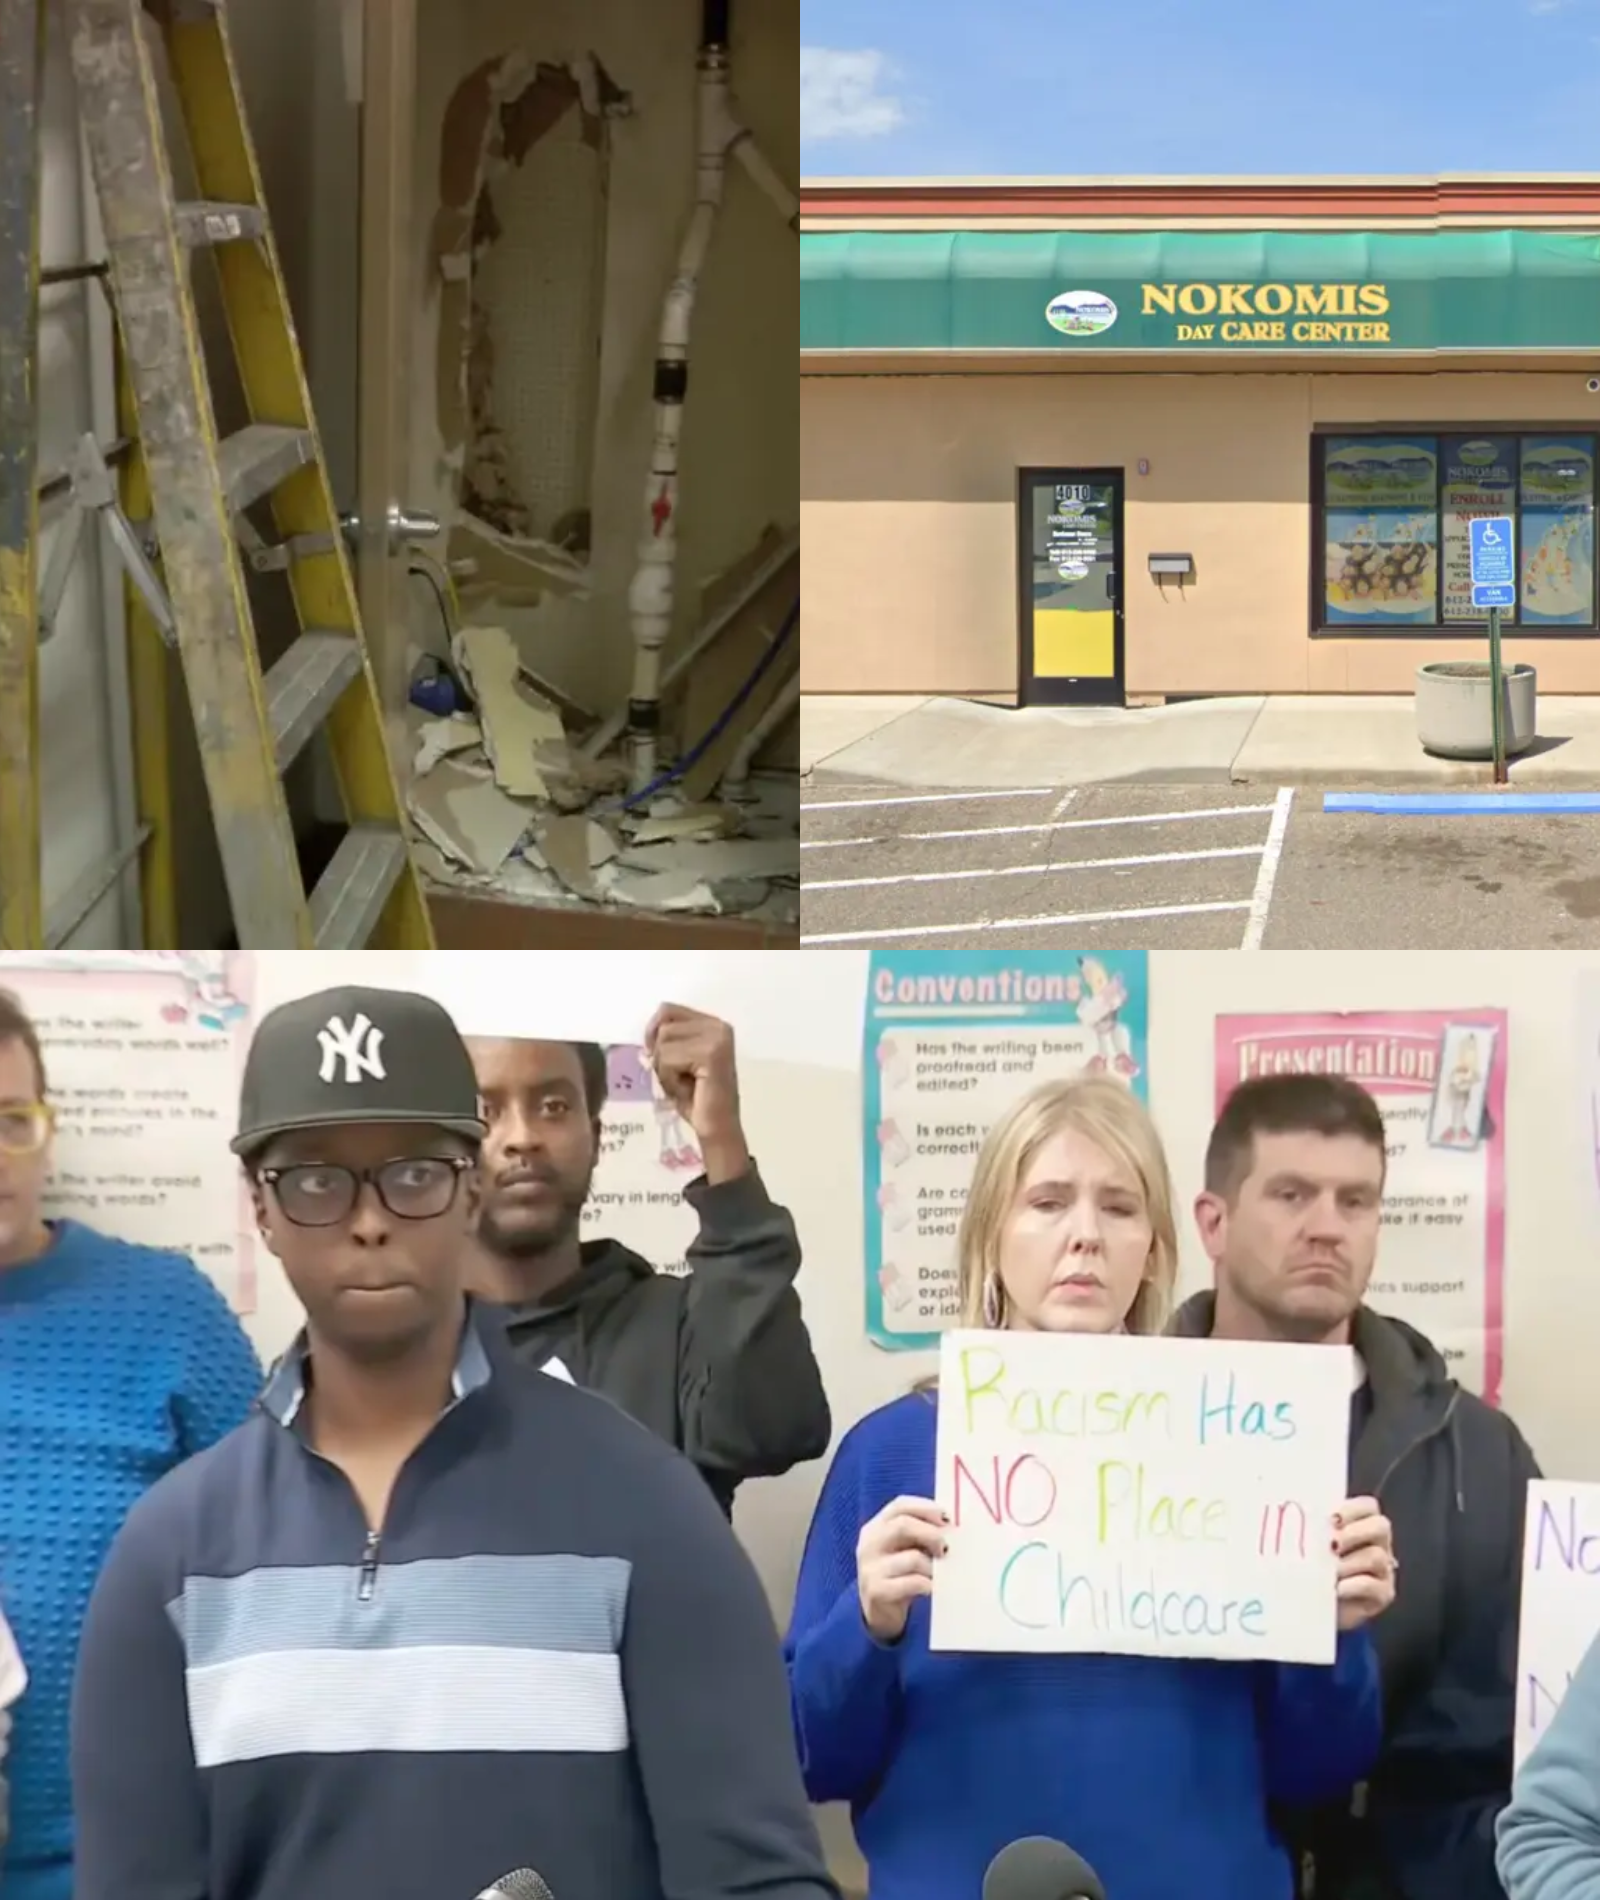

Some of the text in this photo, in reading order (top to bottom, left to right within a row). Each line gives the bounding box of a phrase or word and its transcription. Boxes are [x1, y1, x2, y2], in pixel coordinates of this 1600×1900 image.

[1141, 284, 1390, 316] NOKOMIS
[1177, 322, 1390, 342] DAY CARE CENTER
[1055, 485, 1090, 500] 4010
[1450, 493, 1506, 505] ENROLL
[1485, 589, 1502, 597] VAN
[874, 968, 1081, 1004] Conventions
[316, 1013, 388, 1083] NY
[916, 1039, 1084, 1058] Has the writing been
[1002, 1060, 1035, 1073] and
[1239, 1037, 1435, 1082] Presentation
[915, 1077, 979, 1091] edited?
[916, 1124, 930, 1137] Is
[935, 1123, 976, 1136] each
[593, 1188, 689, 1207] vary in leng
[917, 1186, 945, 1199] Are
[1424, 1213, 1465, 1227] easy
[917, 1223, 957, 1236] used
[1402, 1280, 1466, 1296] support
[918, 1305, 935, 1317] or
[959, 1346, 1298, 1444] Racism Has
[953, 1452, 1307, 1558] NO Place in
[999, 1541, 1268, 1642] Childcare
